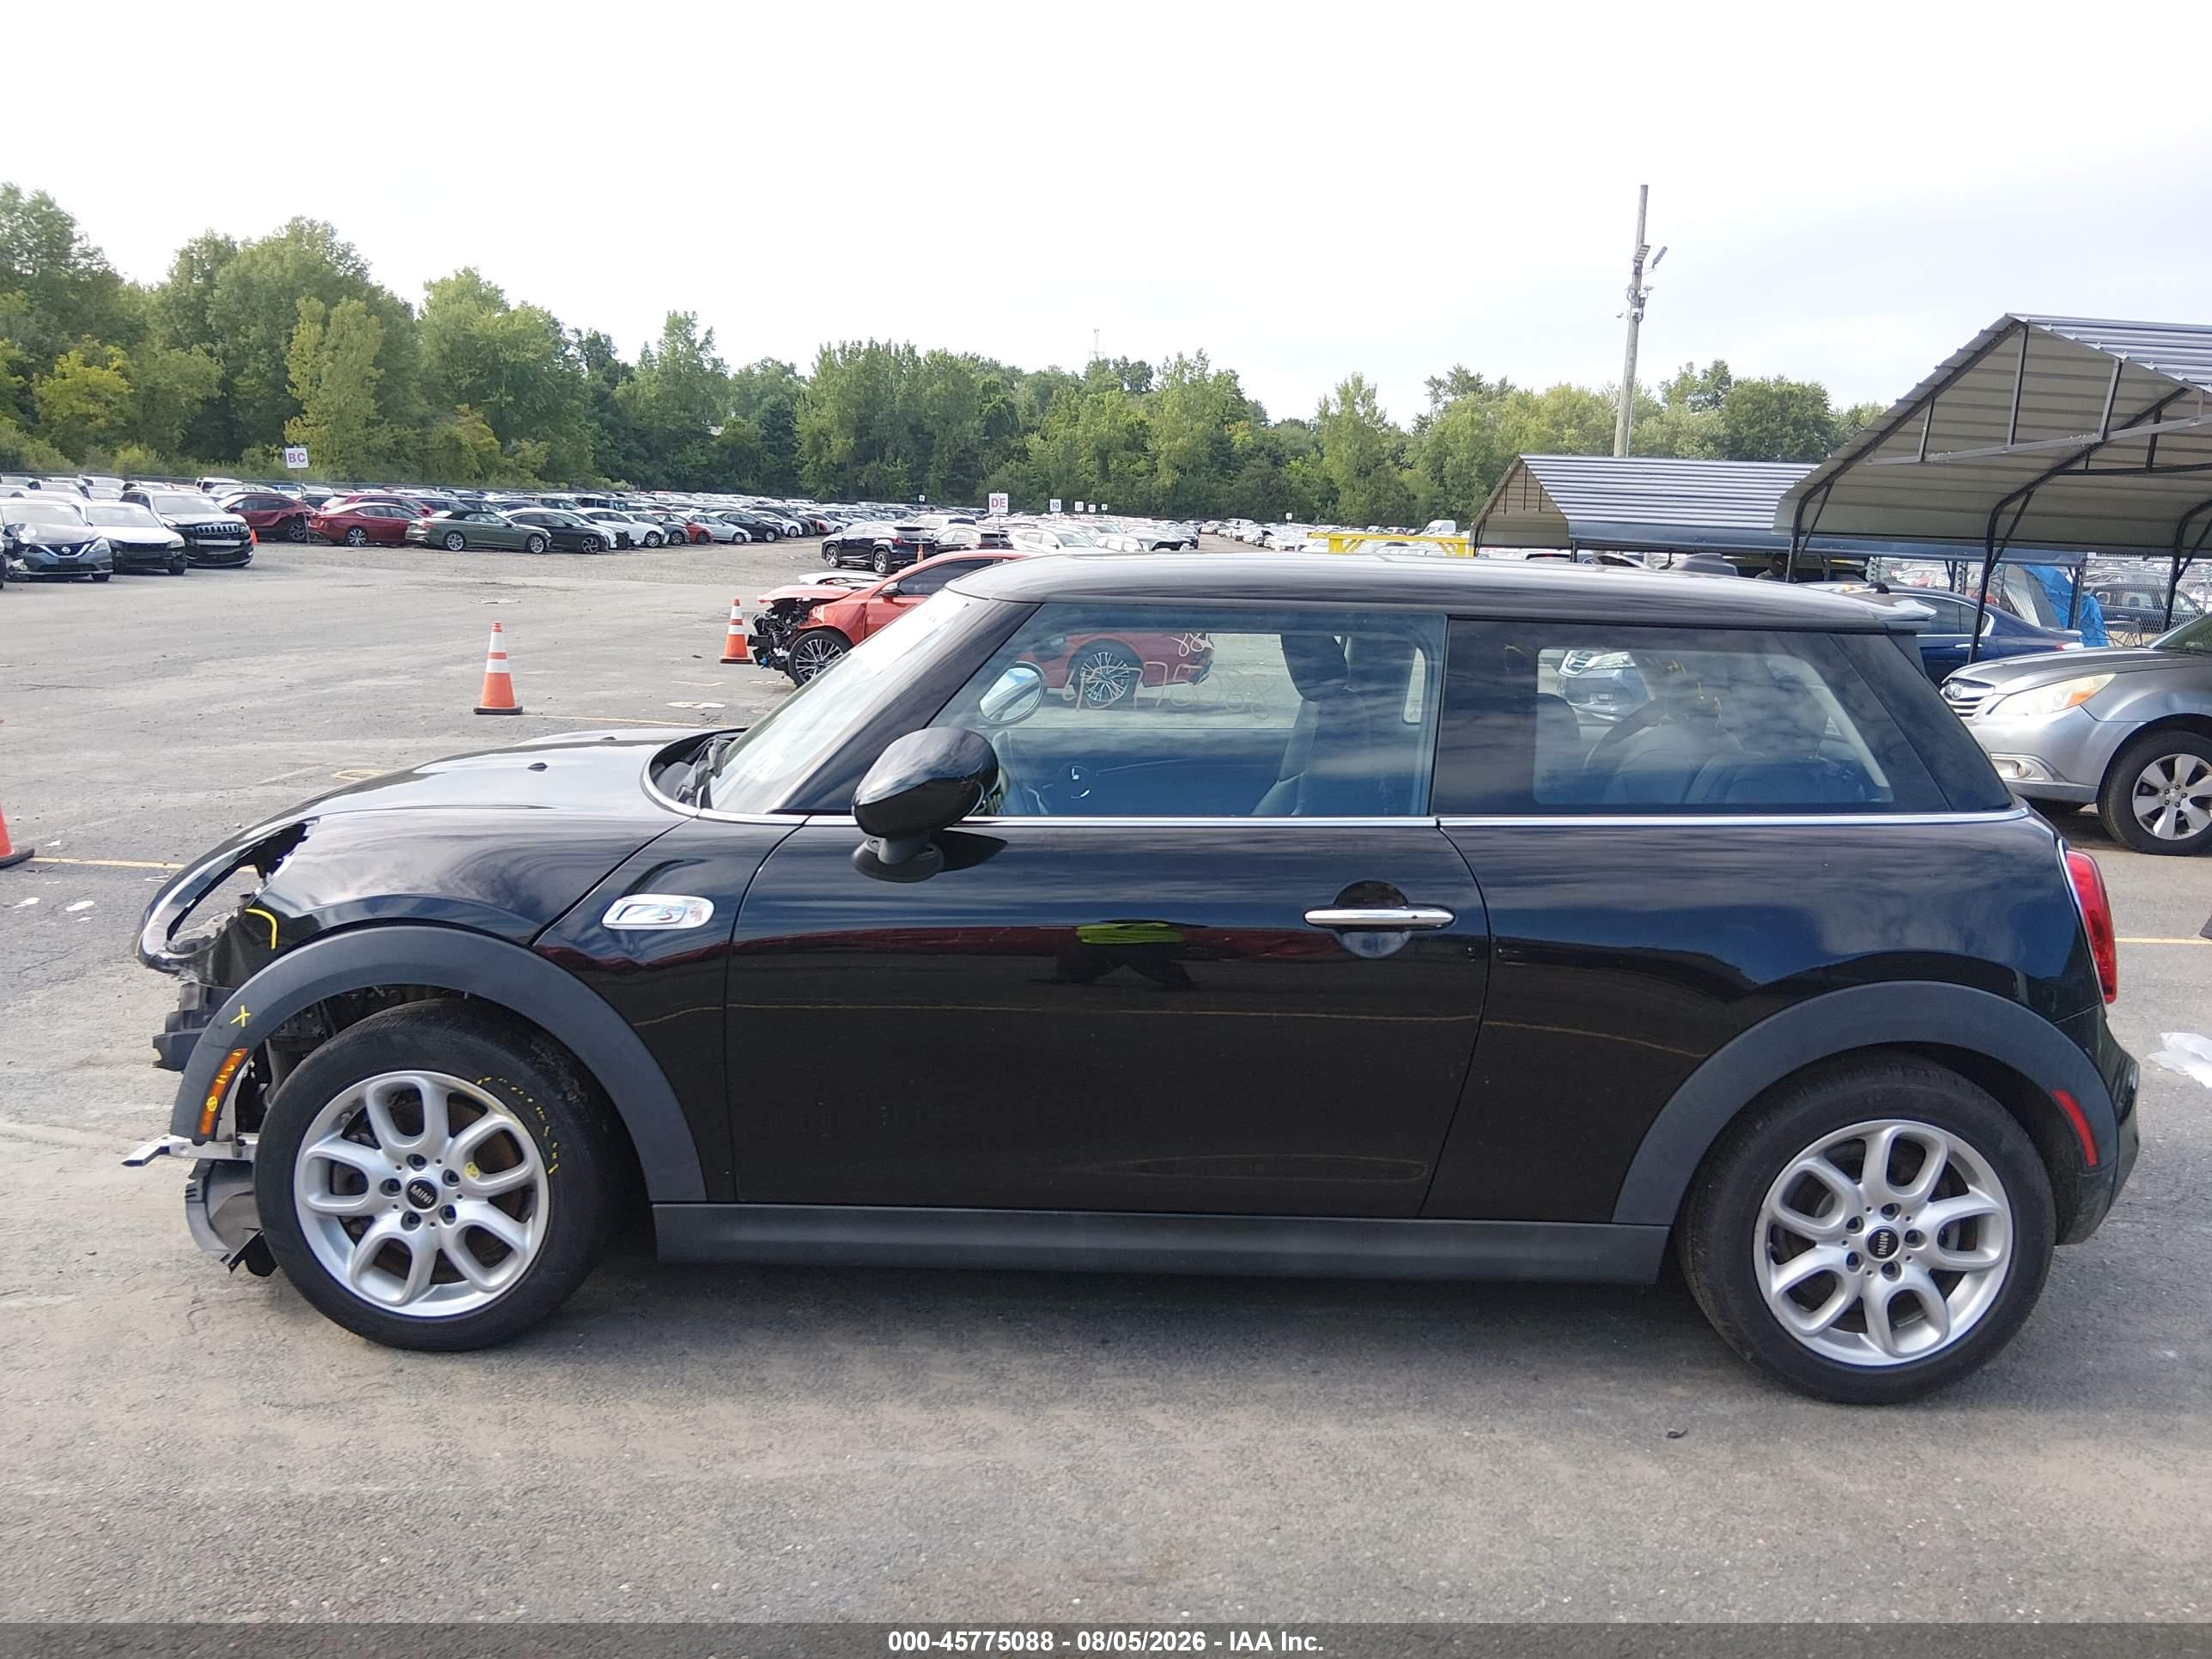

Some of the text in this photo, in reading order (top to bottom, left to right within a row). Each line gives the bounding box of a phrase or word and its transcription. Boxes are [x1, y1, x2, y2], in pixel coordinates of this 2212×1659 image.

[288, 453, 307, 463] BC
[991, 497, 1006, 508] DE
[410, 1184, 434, 1204] MINI
[1877, 1231, 1889, 1255] MINI
